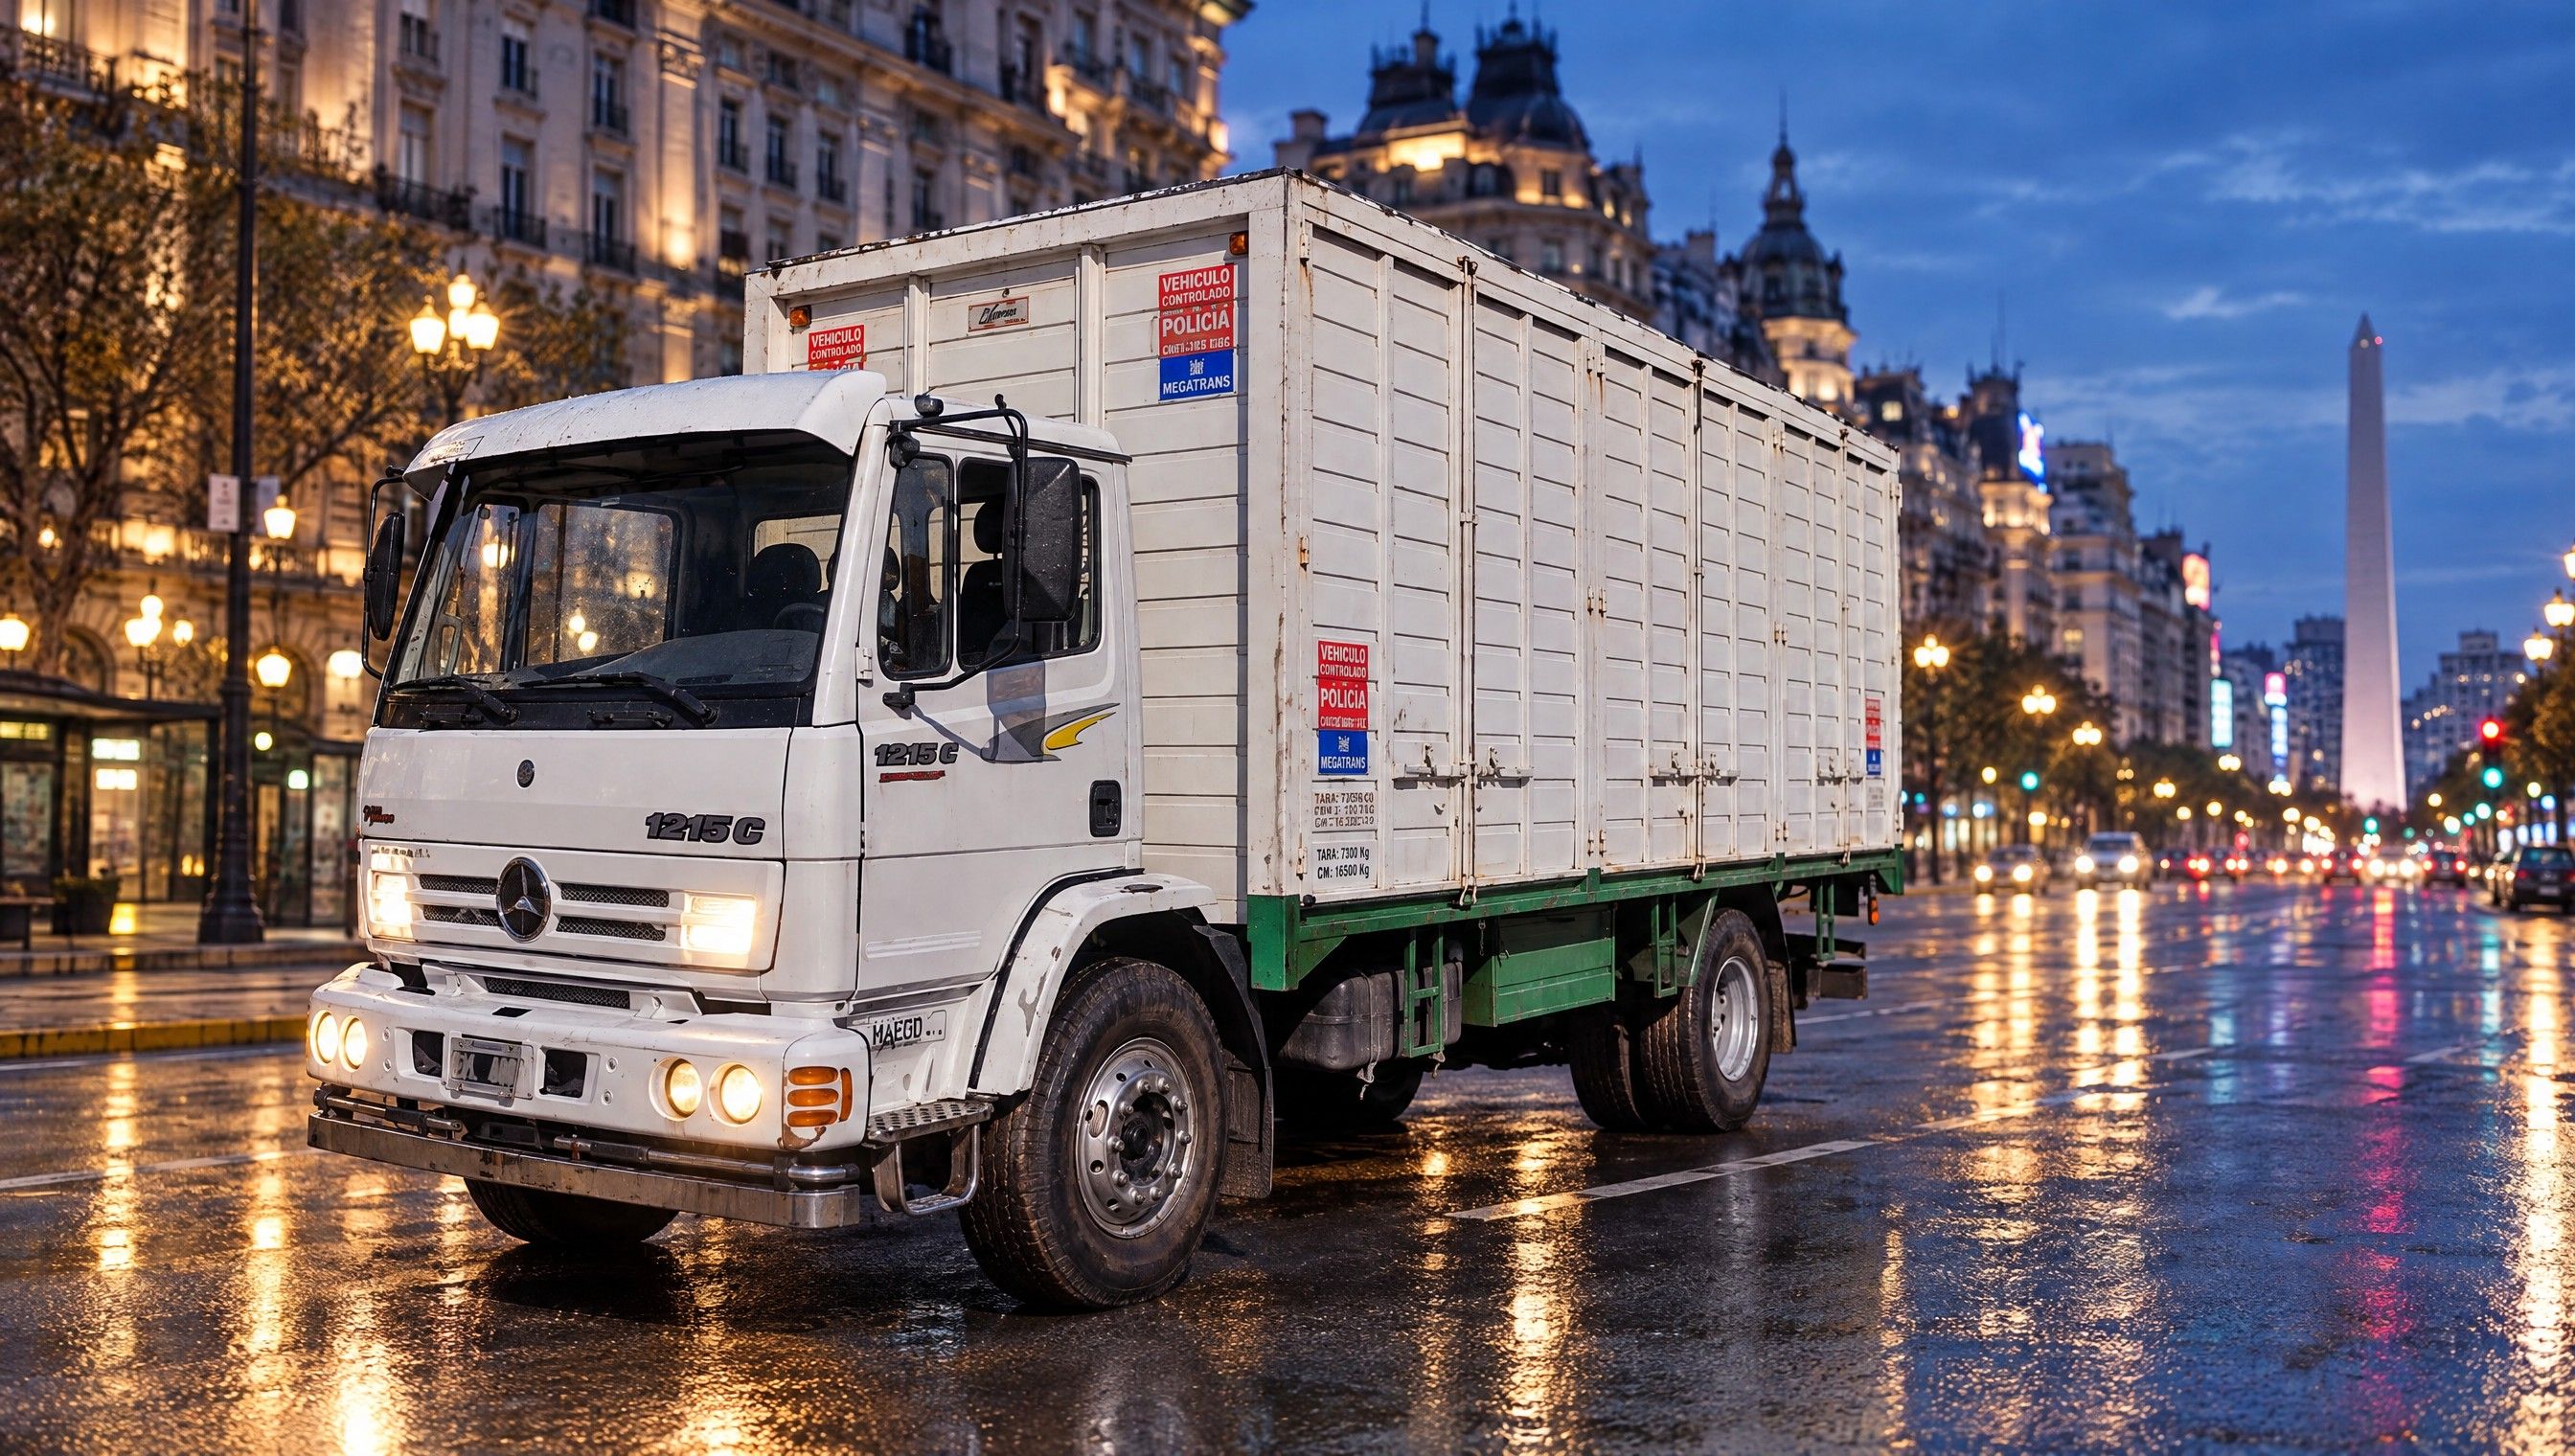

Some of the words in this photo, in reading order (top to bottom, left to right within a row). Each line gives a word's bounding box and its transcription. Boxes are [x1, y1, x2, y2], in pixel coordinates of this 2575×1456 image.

[1162, 268, 1230, 293] VEHICULO
[1162, 285, 1231, 307] CONTROLADO
[811, 328, 861, 348] VEHICULO
[810, 343, 862, 360] CONTROLADO
[1162, 375, 1231, 395] MEGATRANS
[1320, 644, 1366, 664] VEHICULO
[874, 742, 938, 767] 1215
[1320, 756, 1366, 769] MEGATRANS
[645, 811, 734, 844] 1215
[732, 816, 766, 845] C
[1316, 848, 1340, 861] TARA:
[1359, 846, 1370, 861] Kg
[1317, 866, 1333, 879] CM:
[1334, 864, 1357, 877] 16500
[1359, 863, 1370, 879] Kg
